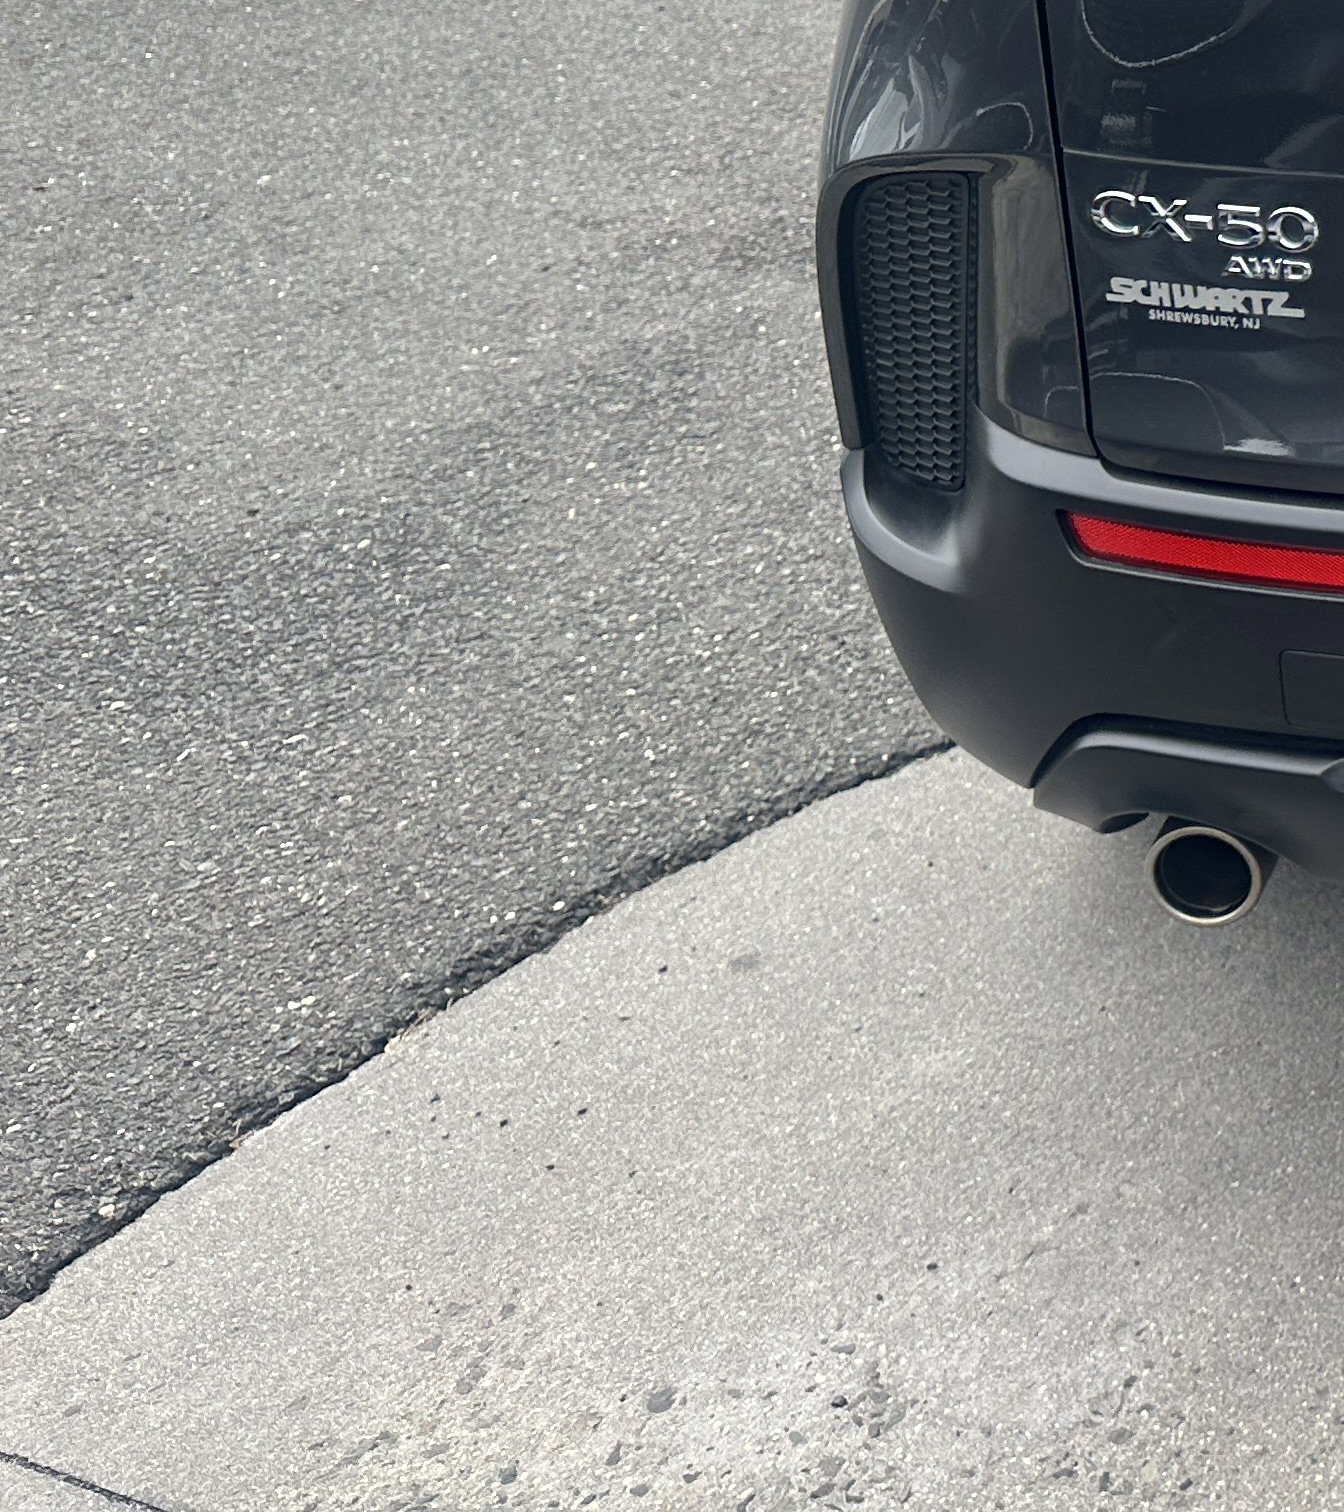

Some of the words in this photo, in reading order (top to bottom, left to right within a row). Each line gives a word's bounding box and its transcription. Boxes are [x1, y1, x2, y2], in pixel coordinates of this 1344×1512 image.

[1090, 190, 1319, 253] CX-50
[1222, 255, 1313, 281] AWD
[1105, 276, 1306, 319] SCHWARTZ
[1148, 308, 1239, 330] SHREWSBURY,
[1242, 318, 1262, 330] NJ
